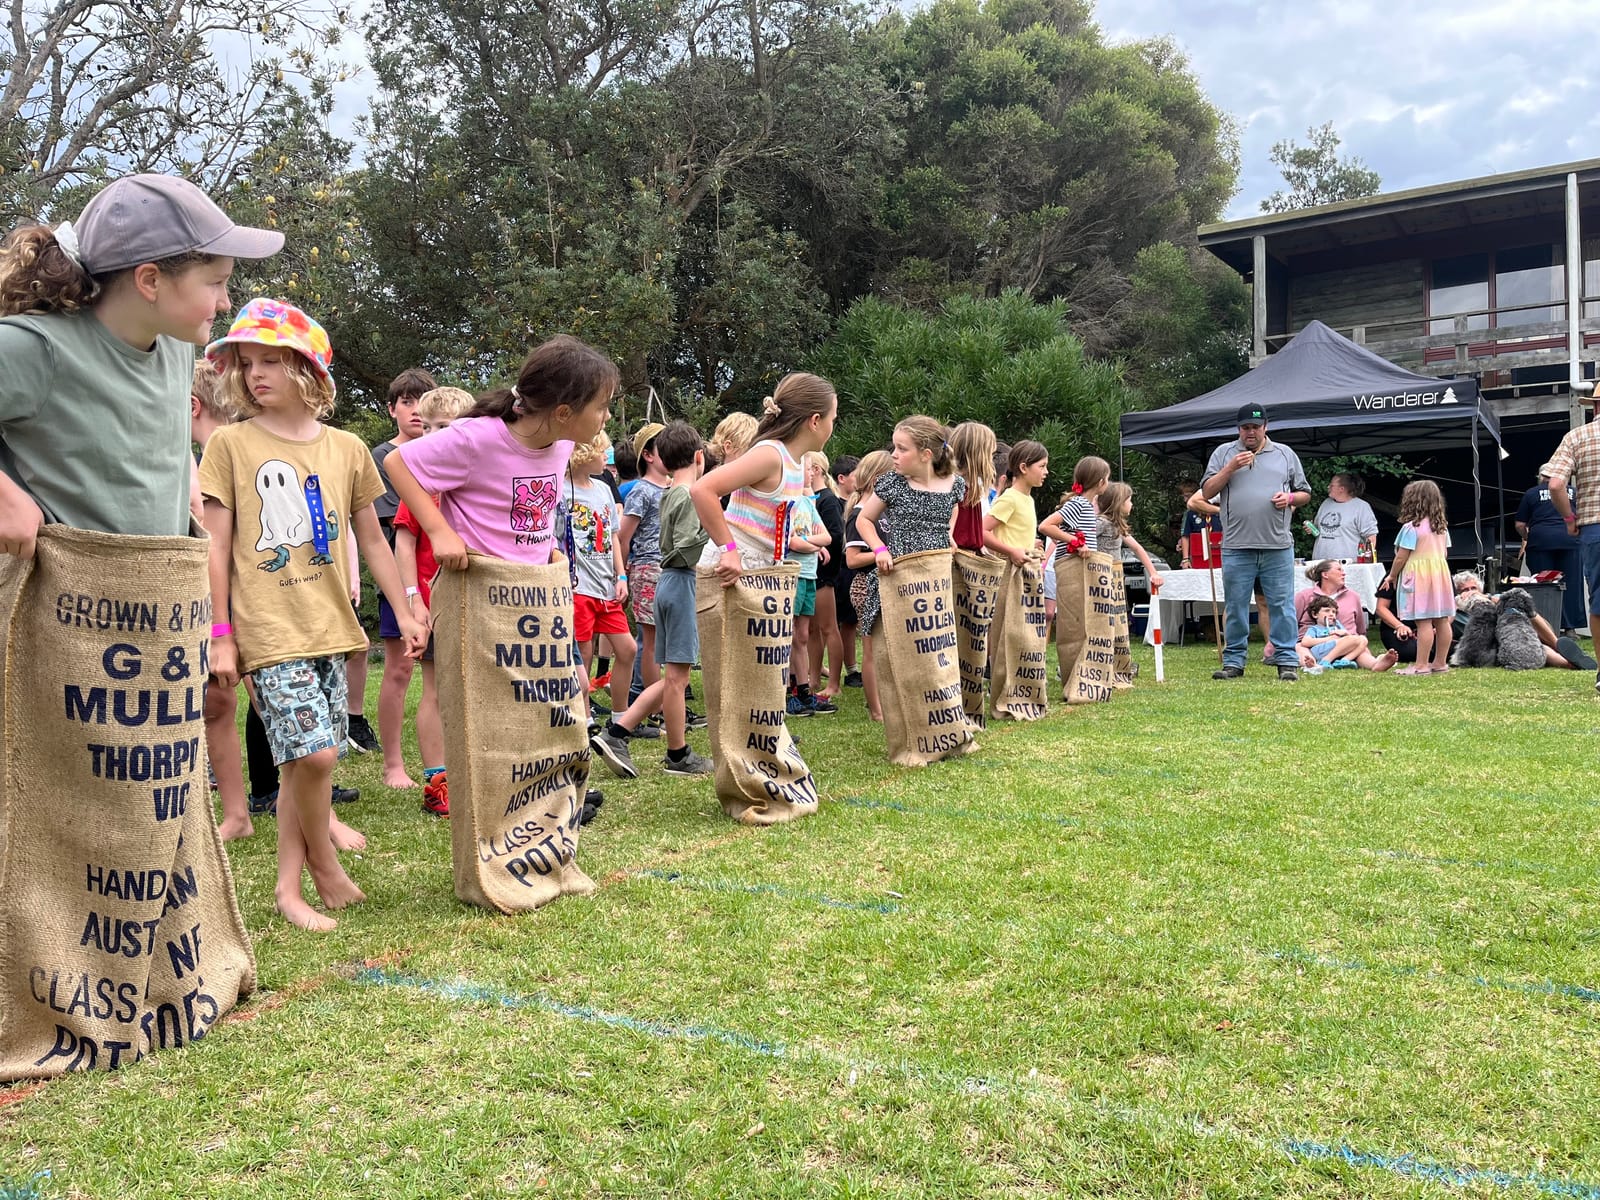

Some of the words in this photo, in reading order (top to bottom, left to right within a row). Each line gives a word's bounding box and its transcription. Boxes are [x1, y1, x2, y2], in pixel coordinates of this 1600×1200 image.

[1353, 392, 1439, 410] Wanderer
[1088, 563, 1110, 573] GROWN
[739, 575, 780, 591] GROWN
[980, 574, 987, 585] &
[1099, 576, 1107, 585] G
[488, 585, 547, 607] GROWN
[552, 587, 560, 607] &
[898, 581, 930, 597] GROWN
[934, 580, 940, 592] &
[976, 590, 987, 603] &
[1036, 583, 1043, 594] &
[56, 592, 158, 633] GROWN
[169, 603, 184, 632] &
[763, 596, 778, 614] G
[783, 597, 791, 615] &
[914, 598, 927, 613] G
[935, 597, 943, 611] &
[517, 615, 540, 638] G
[551, 616, 568, 639] &
[1088, 636, 1112, 648] HAND
[102, 643, 142, 680] G
[161, 646, 190, 682] &
[959, 658, 973, 674] AND
[1020, 652, 1042, 663] HAND
[924, 687, 952, 703] HAND
[750, 709, 785, 726] HAND
[747, 732, 780, 755] AUS
[917, 733, 958, 753] CLASS
[511, 757, 554, 783] HAND
[478, 820, 545, 862] CLASS
[87, 863, 168, 901] HAND
[29, 966, 138, 1023] CLASS
